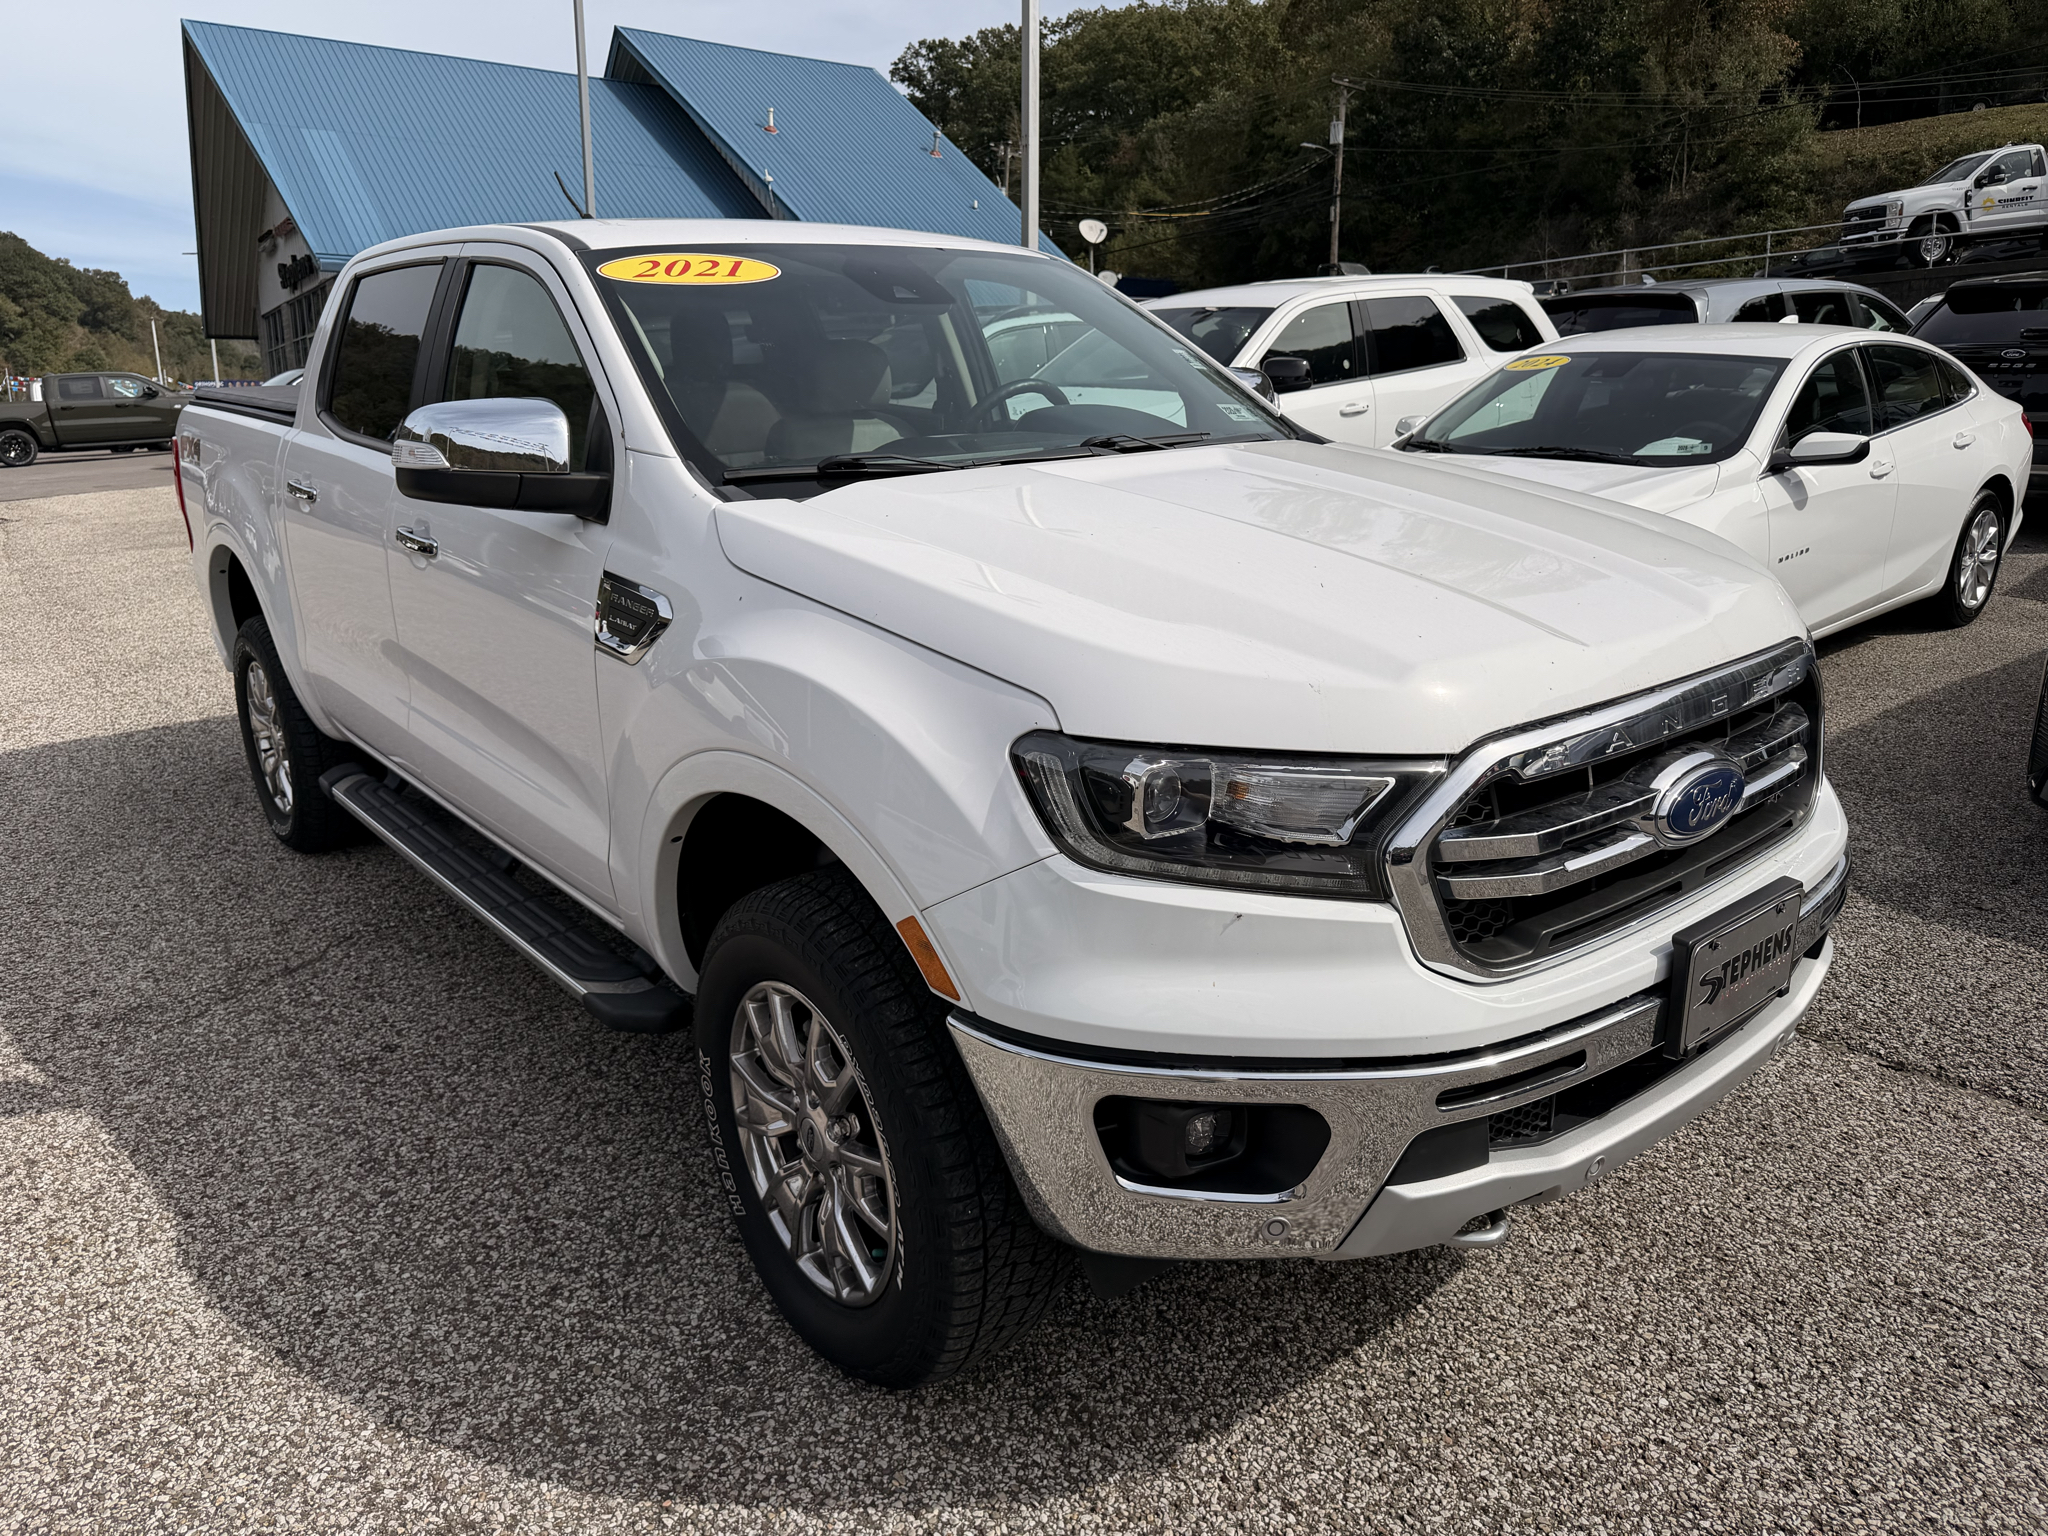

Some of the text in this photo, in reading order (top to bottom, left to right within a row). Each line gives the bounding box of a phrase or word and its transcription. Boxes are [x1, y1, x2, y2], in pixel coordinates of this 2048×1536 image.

[632, 259, 744, 278] 2021
[1777, 547, 1811, 564] MALIBU
[608, 614, 638, 631] LARIAT
[610, 592, 656, 618] RANGER
[1543, 662, 1802, 771] RANGER
[1687, 777, 1739, 828] Ford
[1693, 922, 1794, 1009] STEPHENS
[698, 1047, 747, 1217] HANKOOK
